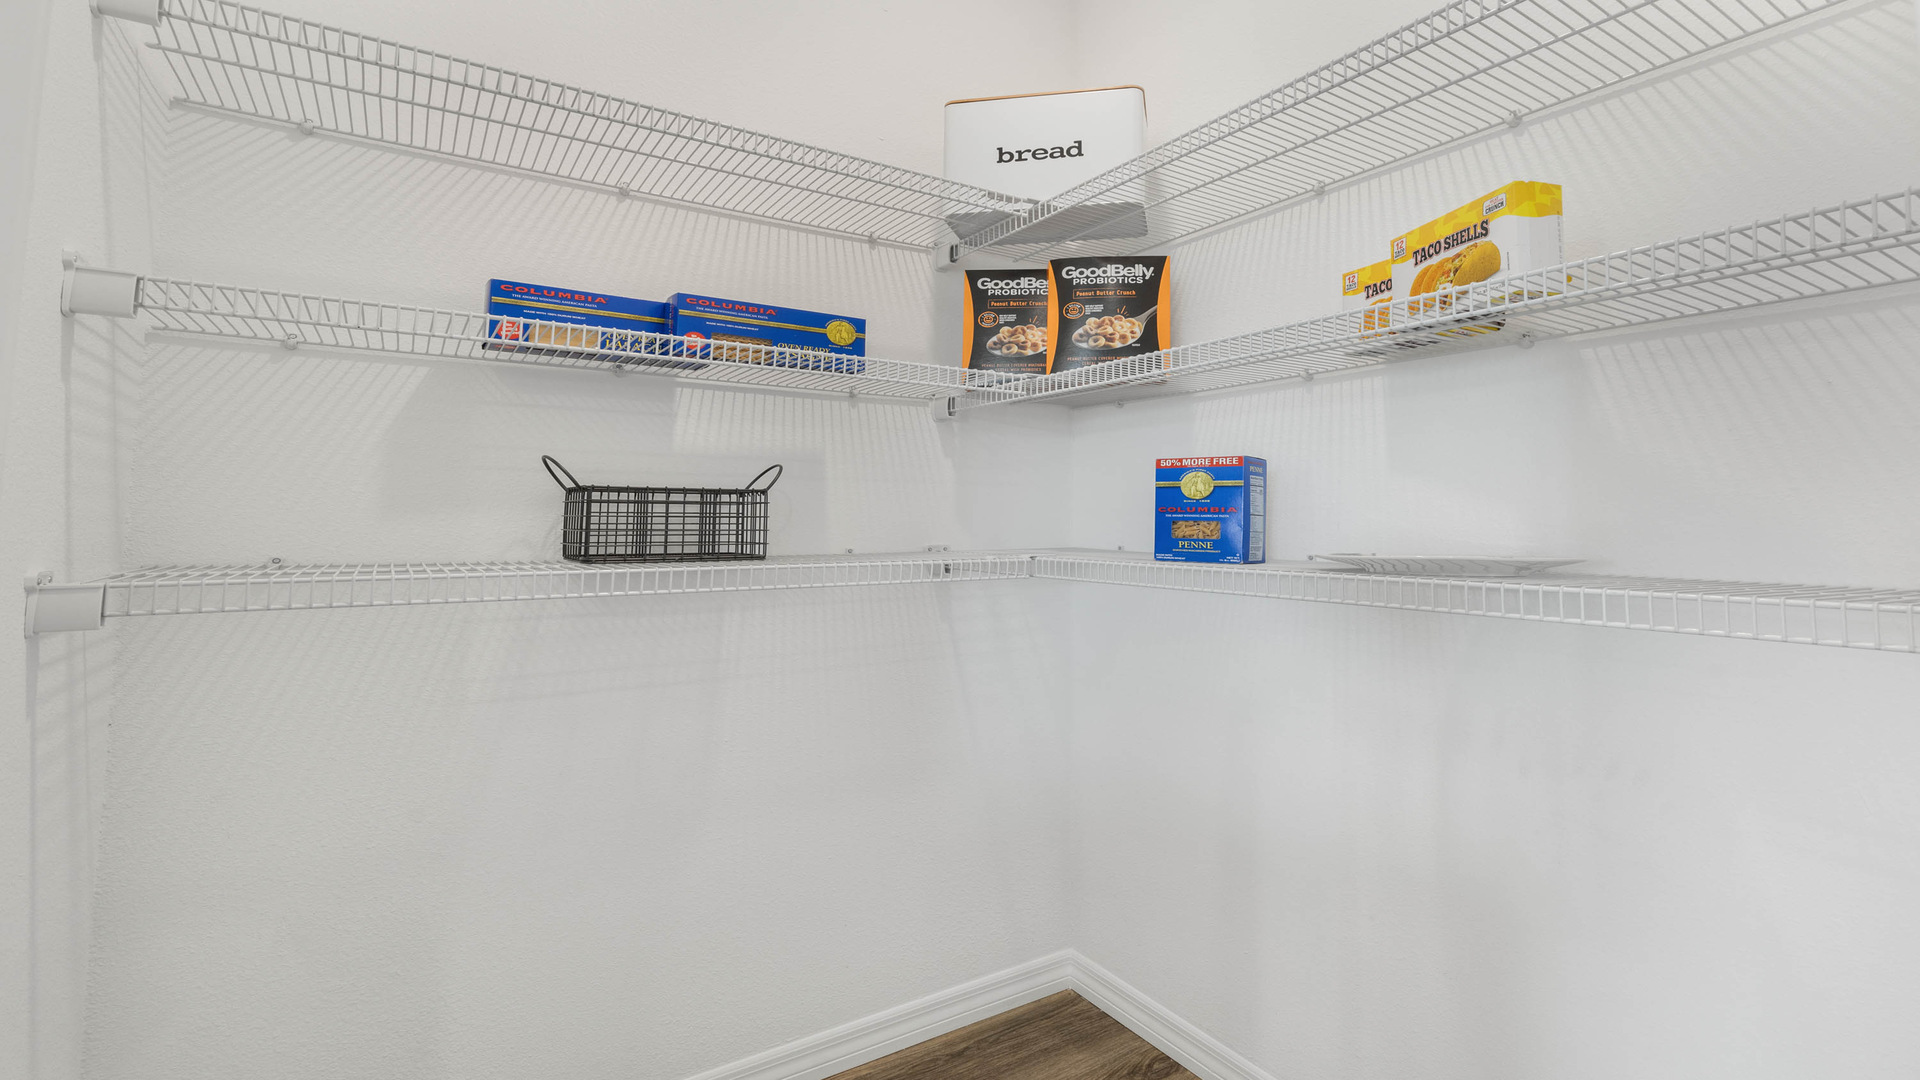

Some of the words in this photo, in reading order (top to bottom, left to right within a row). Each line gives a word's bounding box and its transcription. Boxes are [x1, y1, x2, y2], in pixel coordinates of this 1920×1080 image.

[996, 140, 1084, 164] bread
[1485, 201, 1504, 215] CRUNCH
[1396, 240, 1404, 250] 12
[1413, 240, 1442, 266] TACO
[1443, 219, 1489, 251] SHELLS
[1073, 277, 1143, 286] PROBIOTICS
[1347, 275, 1356, 283] 12
[500, 284, 607, 304] COLUMBIA
[1364, 278, 1392, 299] TACO
[686, 298, 776, 316] COLUMBIA
[777, 342, 801, 351] OVEN
[803, 345, 831, 353] READY
[1182, 458, 1211, 466] MORE
[1213, 457, 1239, 465] FREE
[1178, 541, 1214, 549] PENNE
